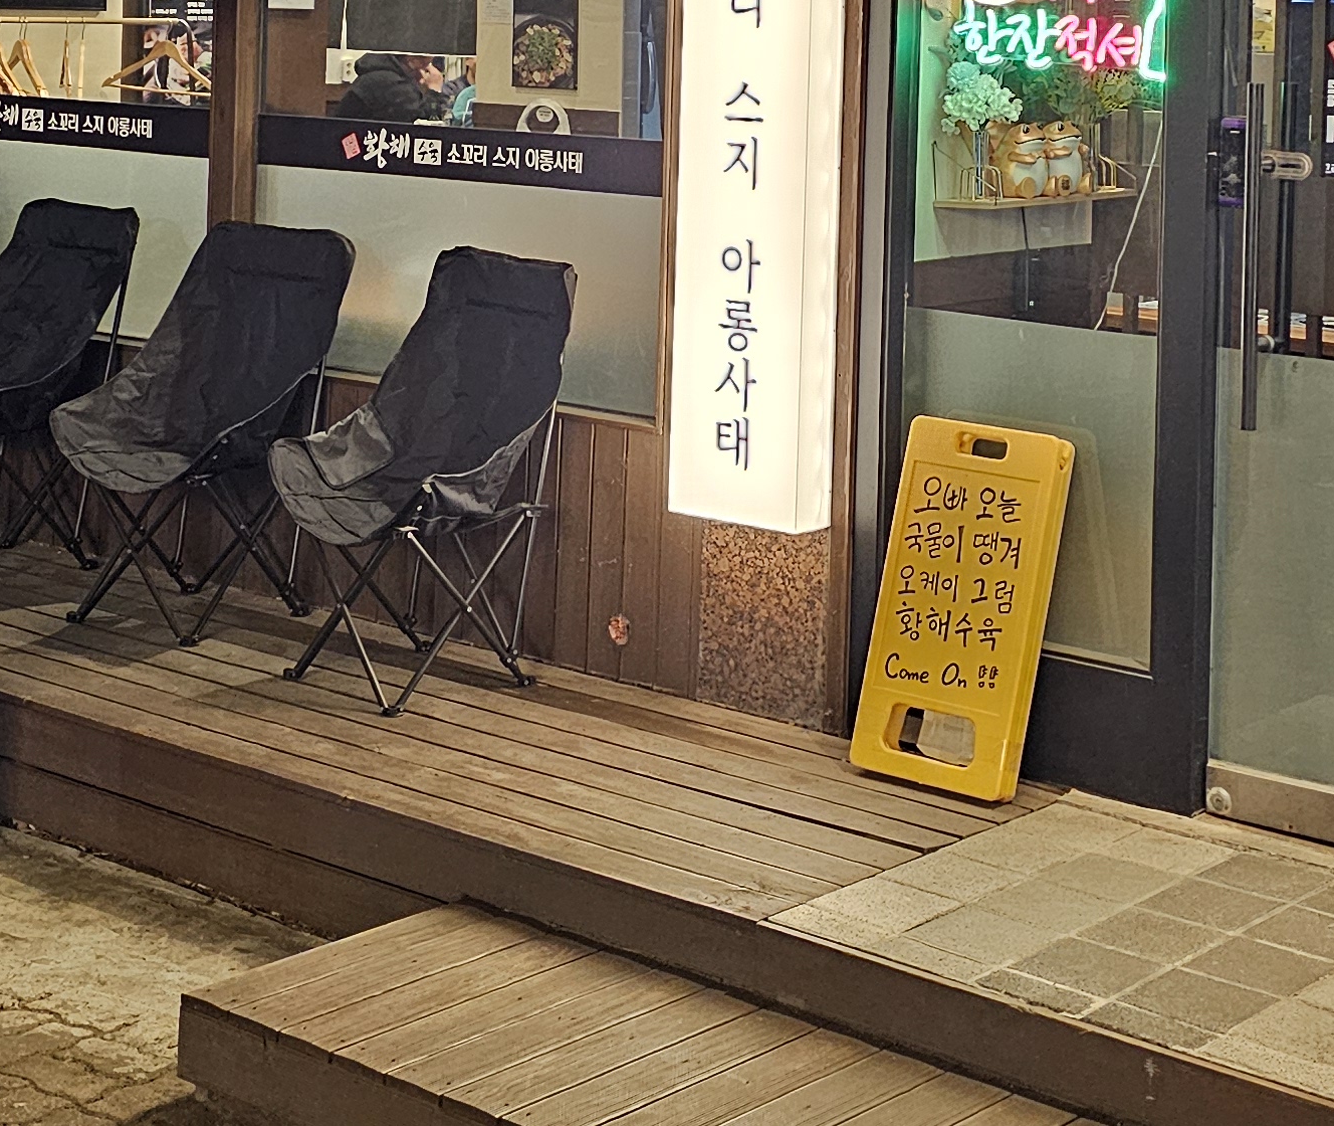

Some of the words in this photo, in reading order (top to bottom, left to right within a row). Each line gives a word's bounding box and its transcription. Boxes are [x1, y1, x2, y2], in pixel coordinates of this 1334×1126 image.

[47, 112, 79, 133] 소꼬리
[82, 114, 104, 135] 스지
[107, 116, 154, 139] 아롱사태
[723, 81, 765, 191] 스지
[363, 128, 411, 169] 황해
[416, 142, 439, 164] 수육
[446, 143, 488, 167] 소꼬리
[491, 147, 521, 170] 스지
[524, 148, 584, 174] 아롱사태
[714, 238, 761, 471] 아롱사태
[913, 476, 968, 514] 오빠
[975, 486, 1022, 524] 오늘
[904, 522, 966, 563] 국물이
[973, 532, 1022, 570] 땡겨
[897, 565, 959, 603] 오케이
[970, 578, 1016, 615] 그럼
[895, 600, 1004, 652] 황해수육
[884, 652, 930, 685] Come
[941, 662, 968, 689] On
